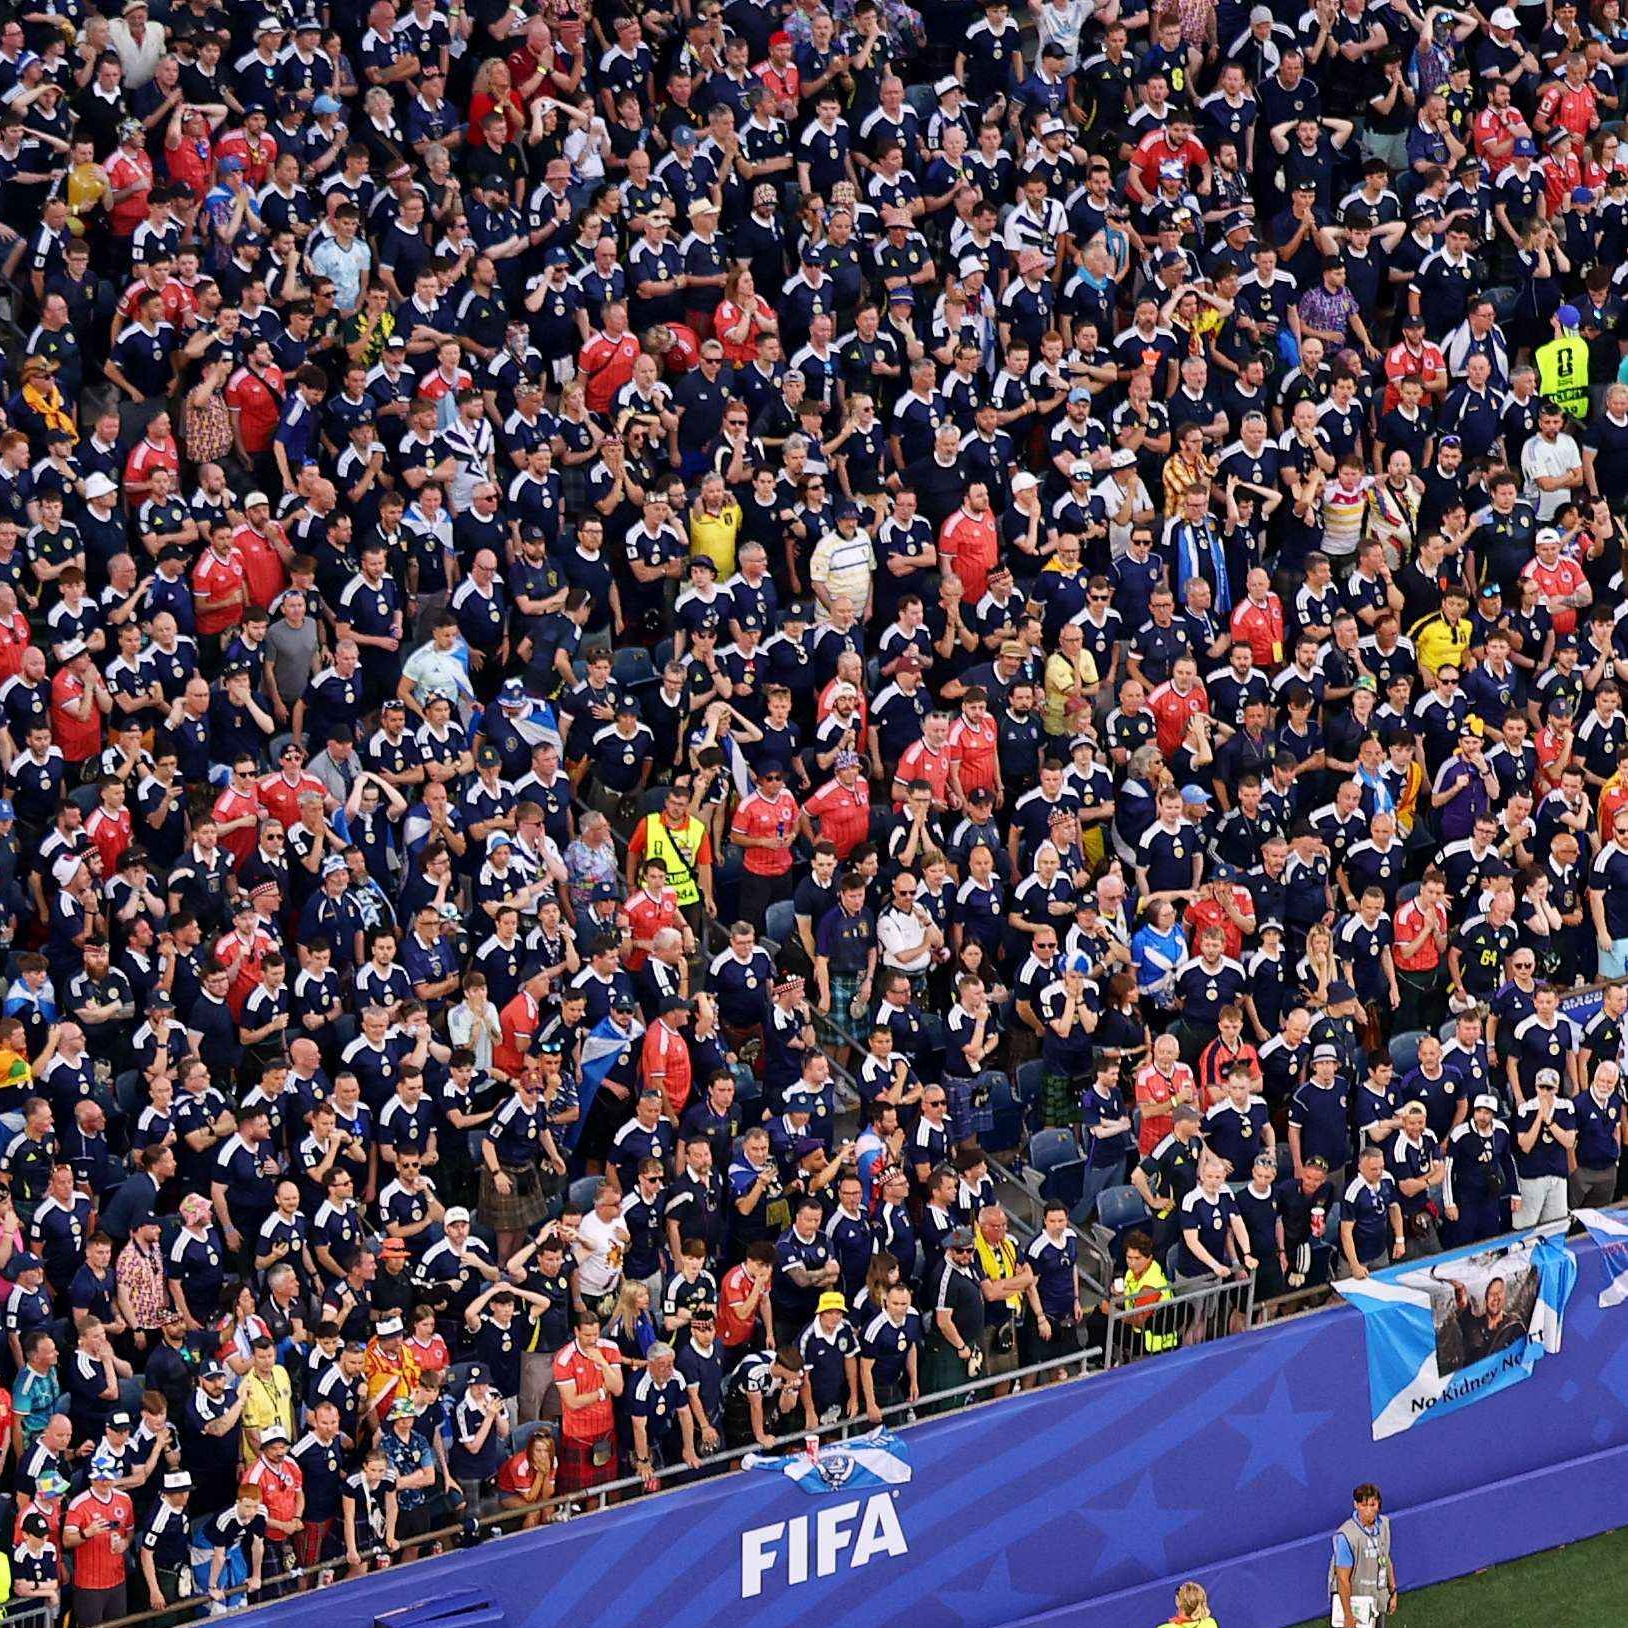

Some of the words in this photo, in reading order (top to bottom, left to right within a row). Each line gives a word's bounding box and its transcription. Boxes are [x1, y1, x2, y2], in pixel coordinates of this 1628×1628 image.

[1480, 949, 1498, 967] 64
[1411, 1396, 1438, 1413] No
[1442, 1366, 1499, 1404] Kidney
[741, 1492, 909, 1599] FIFA
